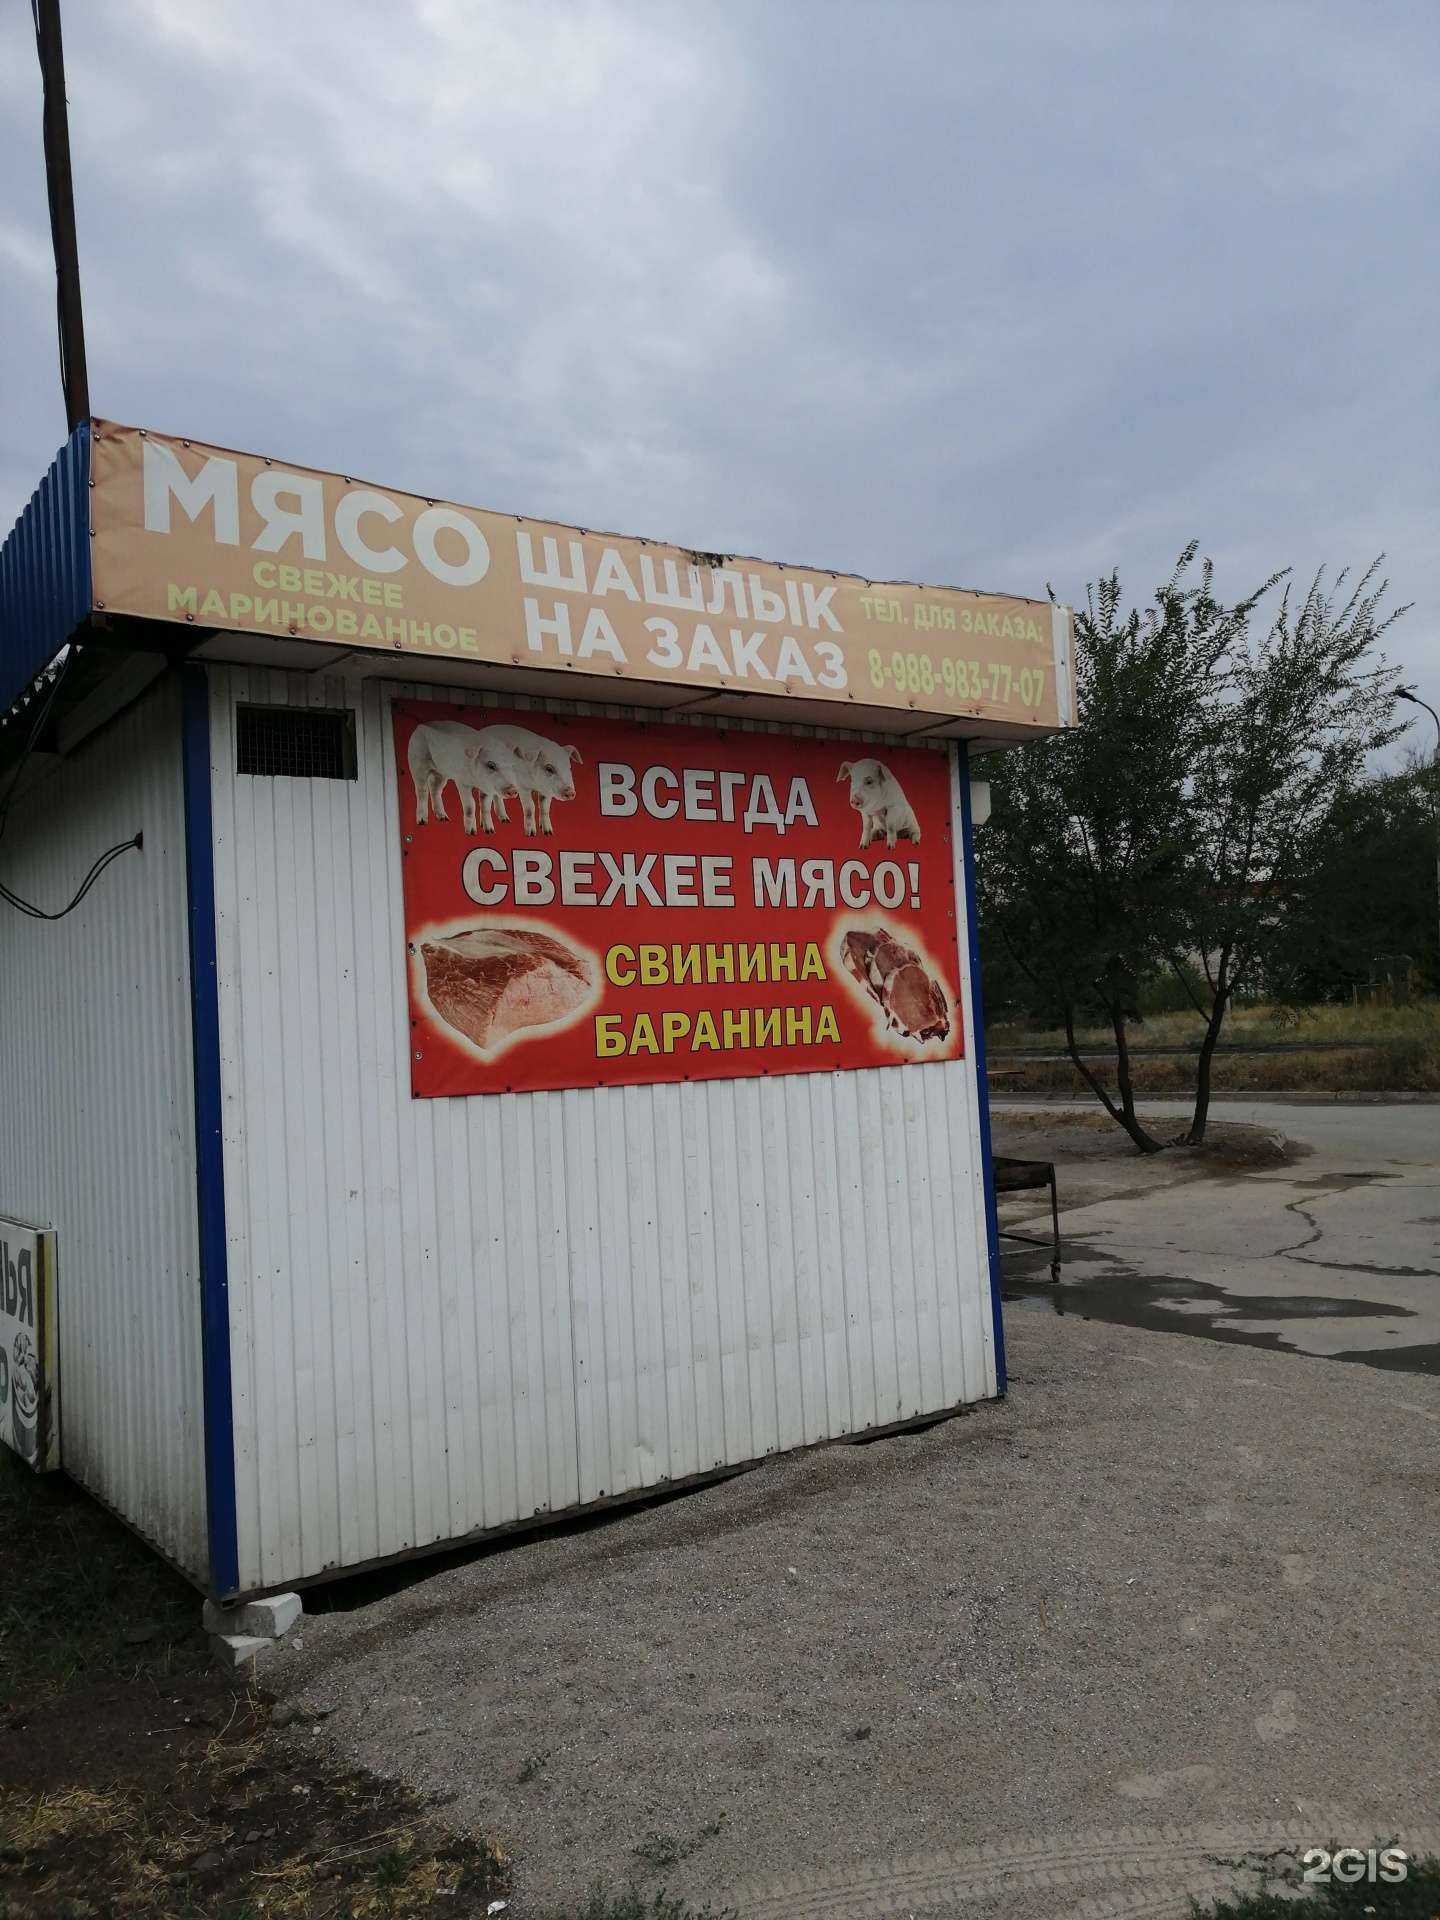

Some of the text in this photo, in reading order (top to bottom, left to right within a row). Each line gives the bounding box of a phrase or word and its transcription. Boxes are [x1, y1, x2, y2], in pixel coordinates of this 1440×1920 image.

[143, 441, 491, 587] МЯСО
[253, 561, 404, 609] СВЕЖЕЕ
[515, 530, 844, 633] ШАШЛЫК
[167, 583, 480, 653] МАРИНОВАННОЕ
[523, 598, 848, 689] НА ЗАКАЗ
[860, 596, 1044, 642] ТЕЛ. ДЛЯ ЗАКАЗА:
[867, 648, 1045, 707] 8-988-983-77-07
[597, 762, 819, 835] ВСЕГДА
[461, 848, 921, 910] СВЕЖЕЕ МЯСО!
[605, 942, 828, 988] СВИНИНА
[594, 1004, 842, 1059] БАРАНИНА
